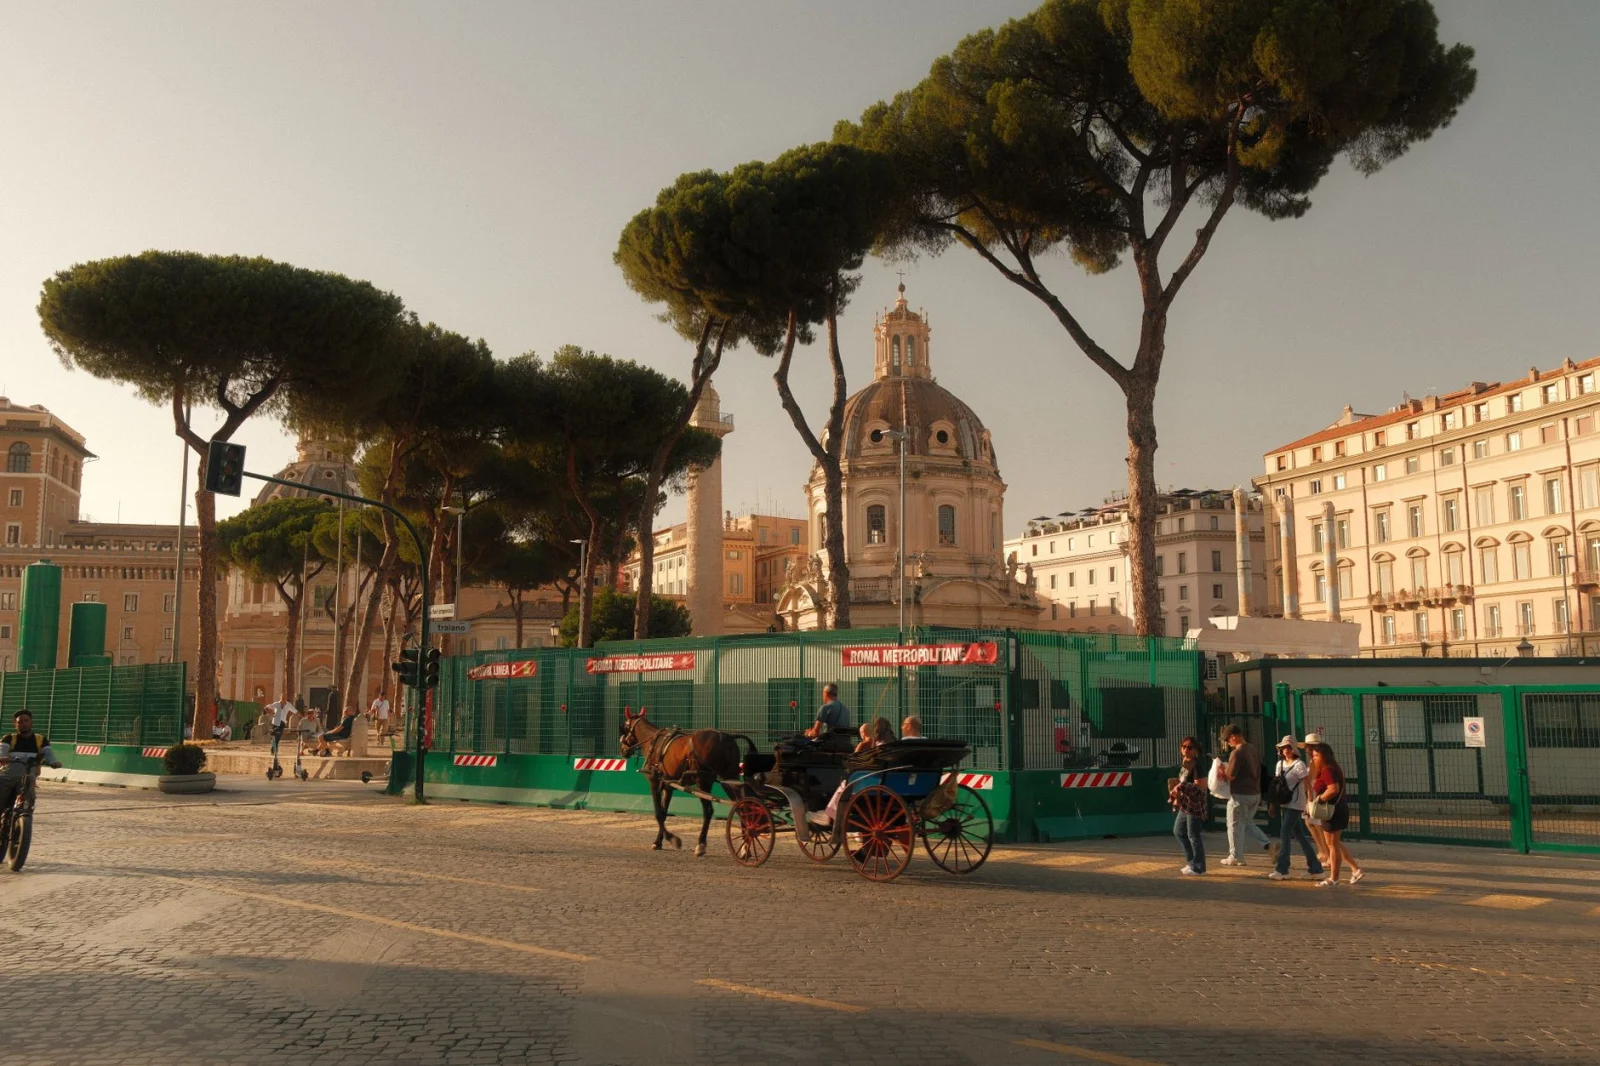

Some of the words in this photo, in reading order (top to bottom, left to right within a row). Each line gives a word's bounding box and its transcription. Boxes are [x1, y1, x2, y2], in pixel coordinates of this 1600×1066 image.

[437, 624, 466, 632] traiano
[850, 650, 880, 663] ROMA
[882, 647, 967, 663] METROPOLITANE
[493, 664, 510, 676] LINEA
[592, 660, 613, 671] ROMA
[614, 657, 674, 671] METROPOLITANE
[1370, 730, 1378, 742] 2
